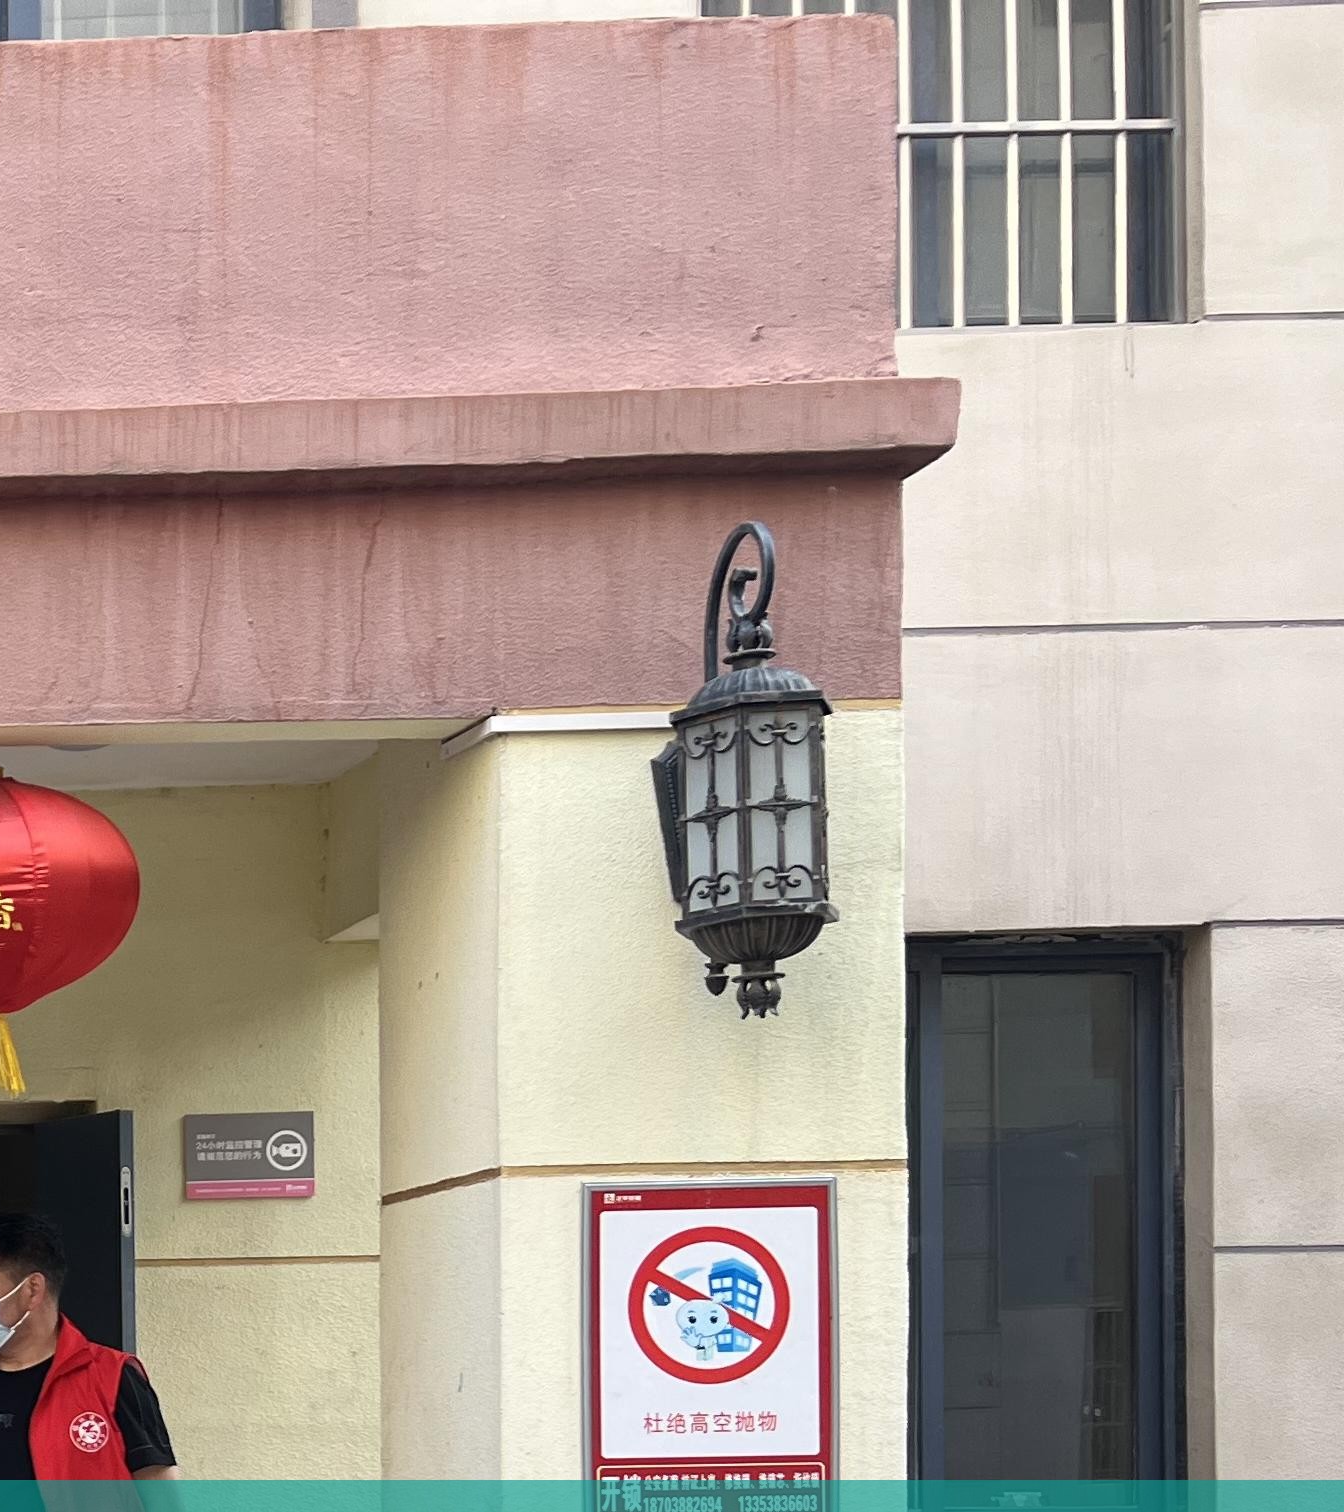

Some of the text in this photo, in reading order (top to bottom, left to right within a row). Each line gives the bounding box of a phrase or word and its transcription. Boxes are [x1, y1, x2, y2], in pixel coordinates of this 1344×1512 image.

[643, 1411, 778, 1435] 杜绝高空抛物
[601, 1473, 642, 1512] 开锁
